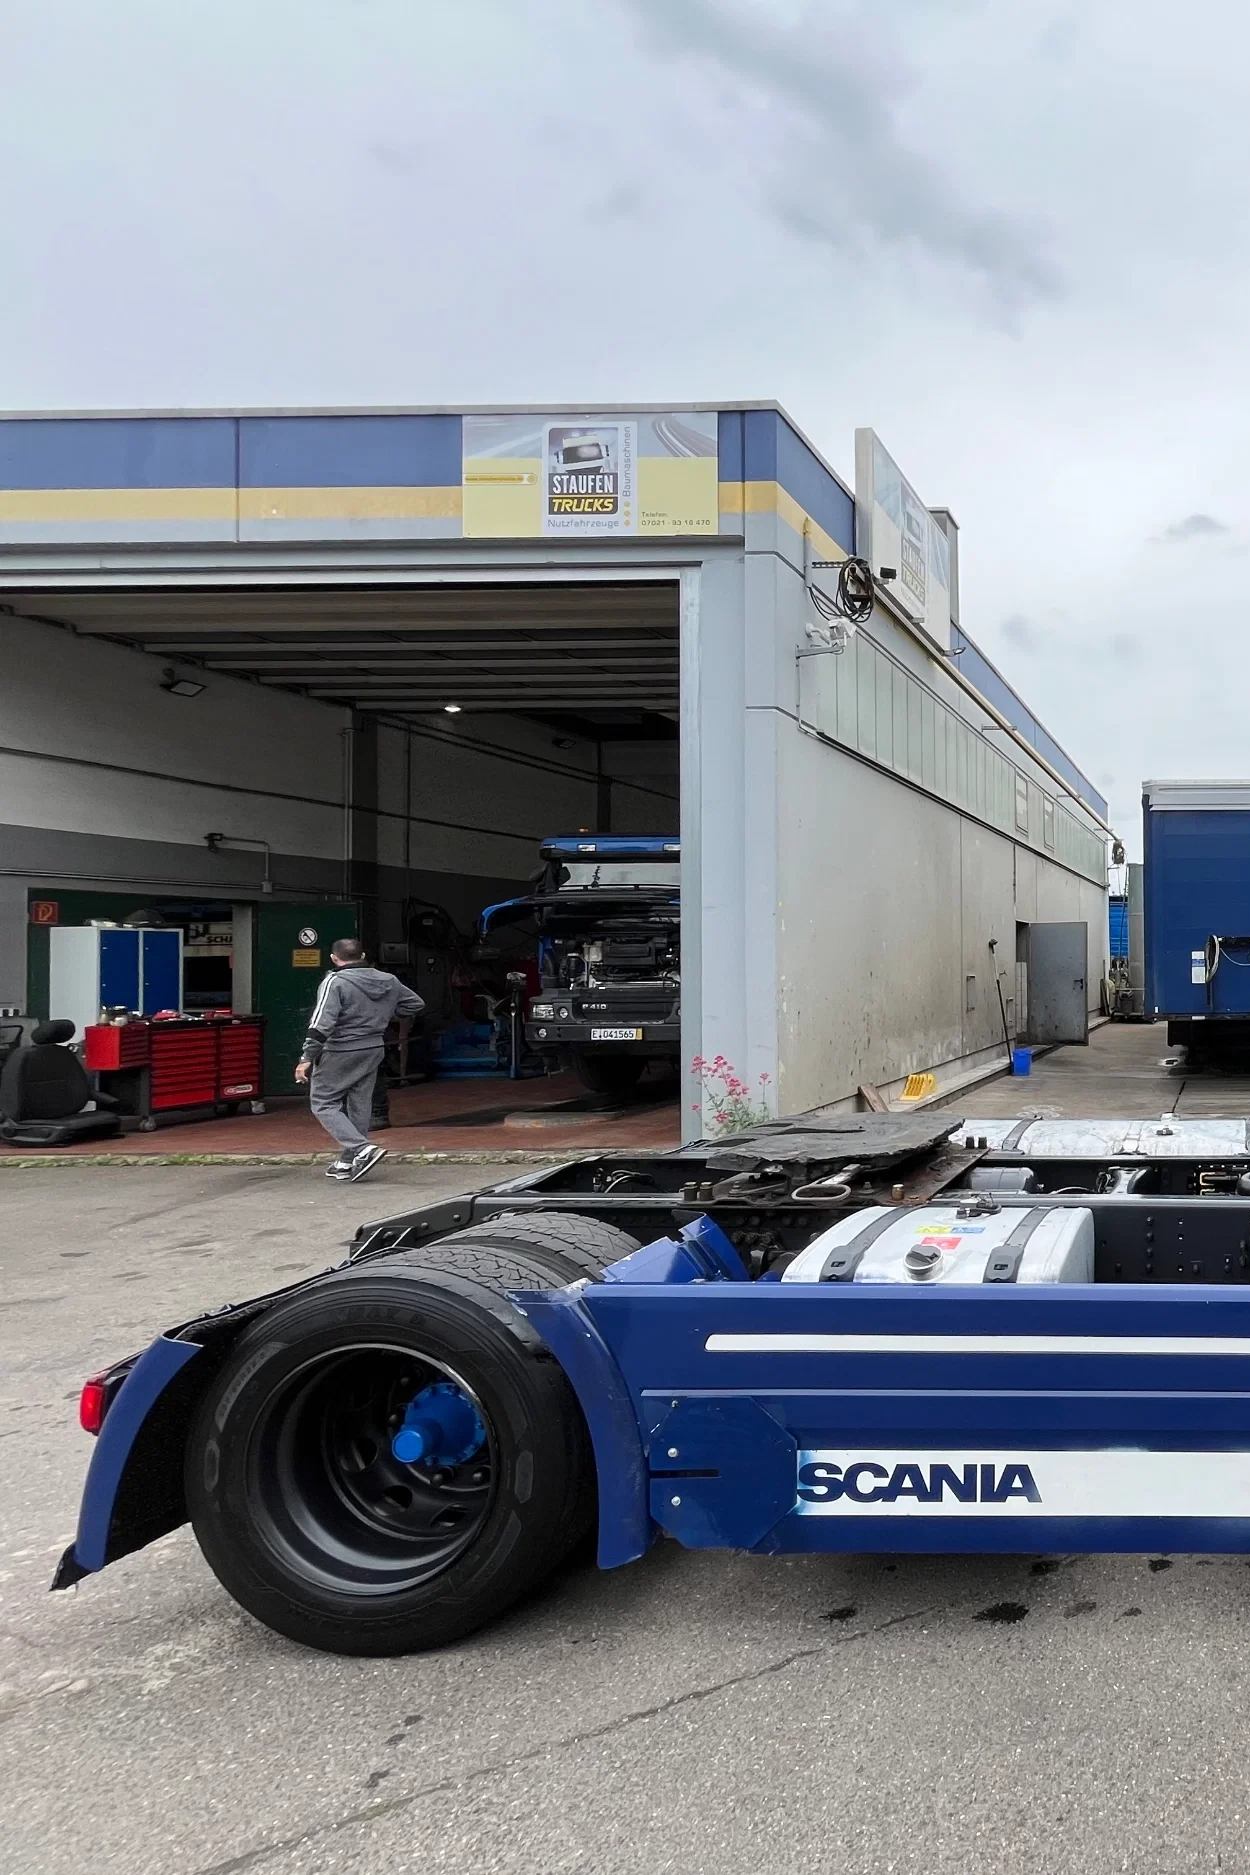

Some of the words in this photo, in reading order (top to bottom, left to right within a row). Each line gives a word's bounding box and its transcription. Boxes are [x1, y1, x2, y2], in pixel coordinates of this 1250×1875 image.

[623, 426, 631, 497] Baumaschinen
[552, 474, 614, 495] STAUFEN
[552, 499, 614, 512] TRUCKS
[548, 519, 619, 530] Nutzfahrzeuge
[797, 1462, 1043, 1503] SCANIA
